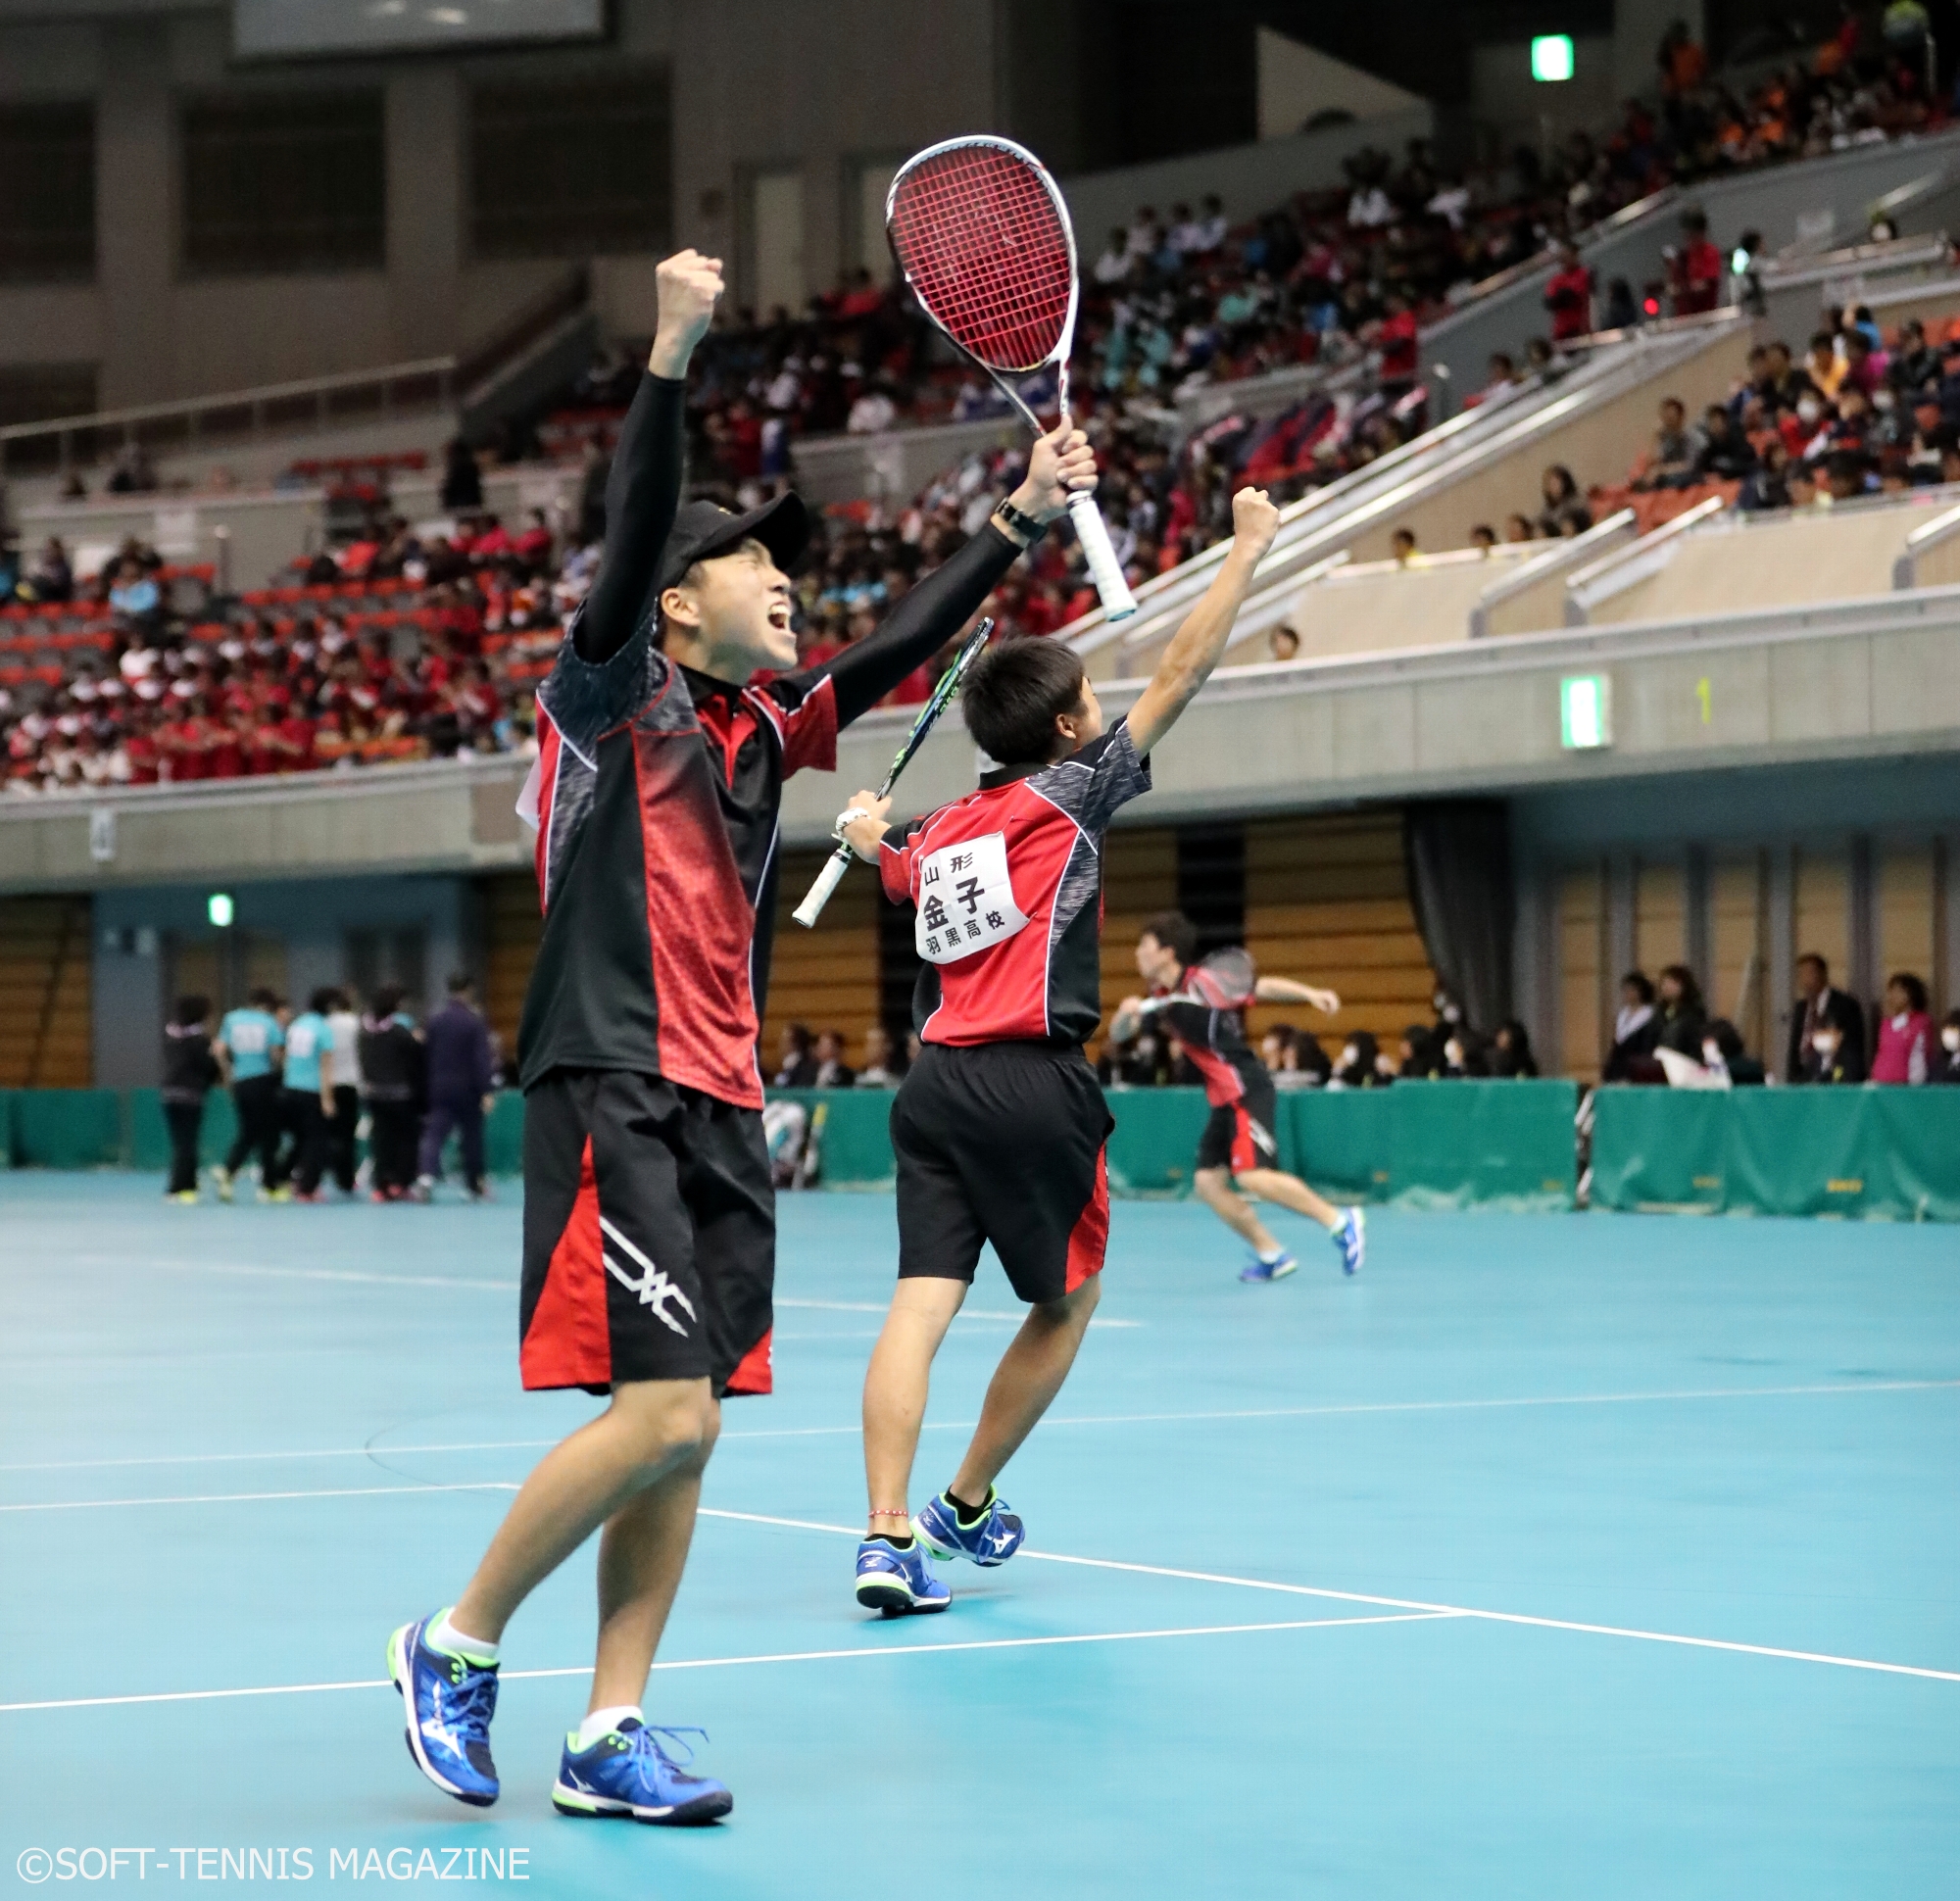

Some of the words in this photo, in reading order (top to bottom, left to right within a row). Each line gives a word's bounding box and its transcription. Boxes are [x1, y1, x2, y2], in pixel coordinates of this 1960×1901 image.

[924, 852, 973, 886] 山形
[923, 876, 985, 932] 金子
[925, 910, 1005, 955] 羽黒高校
